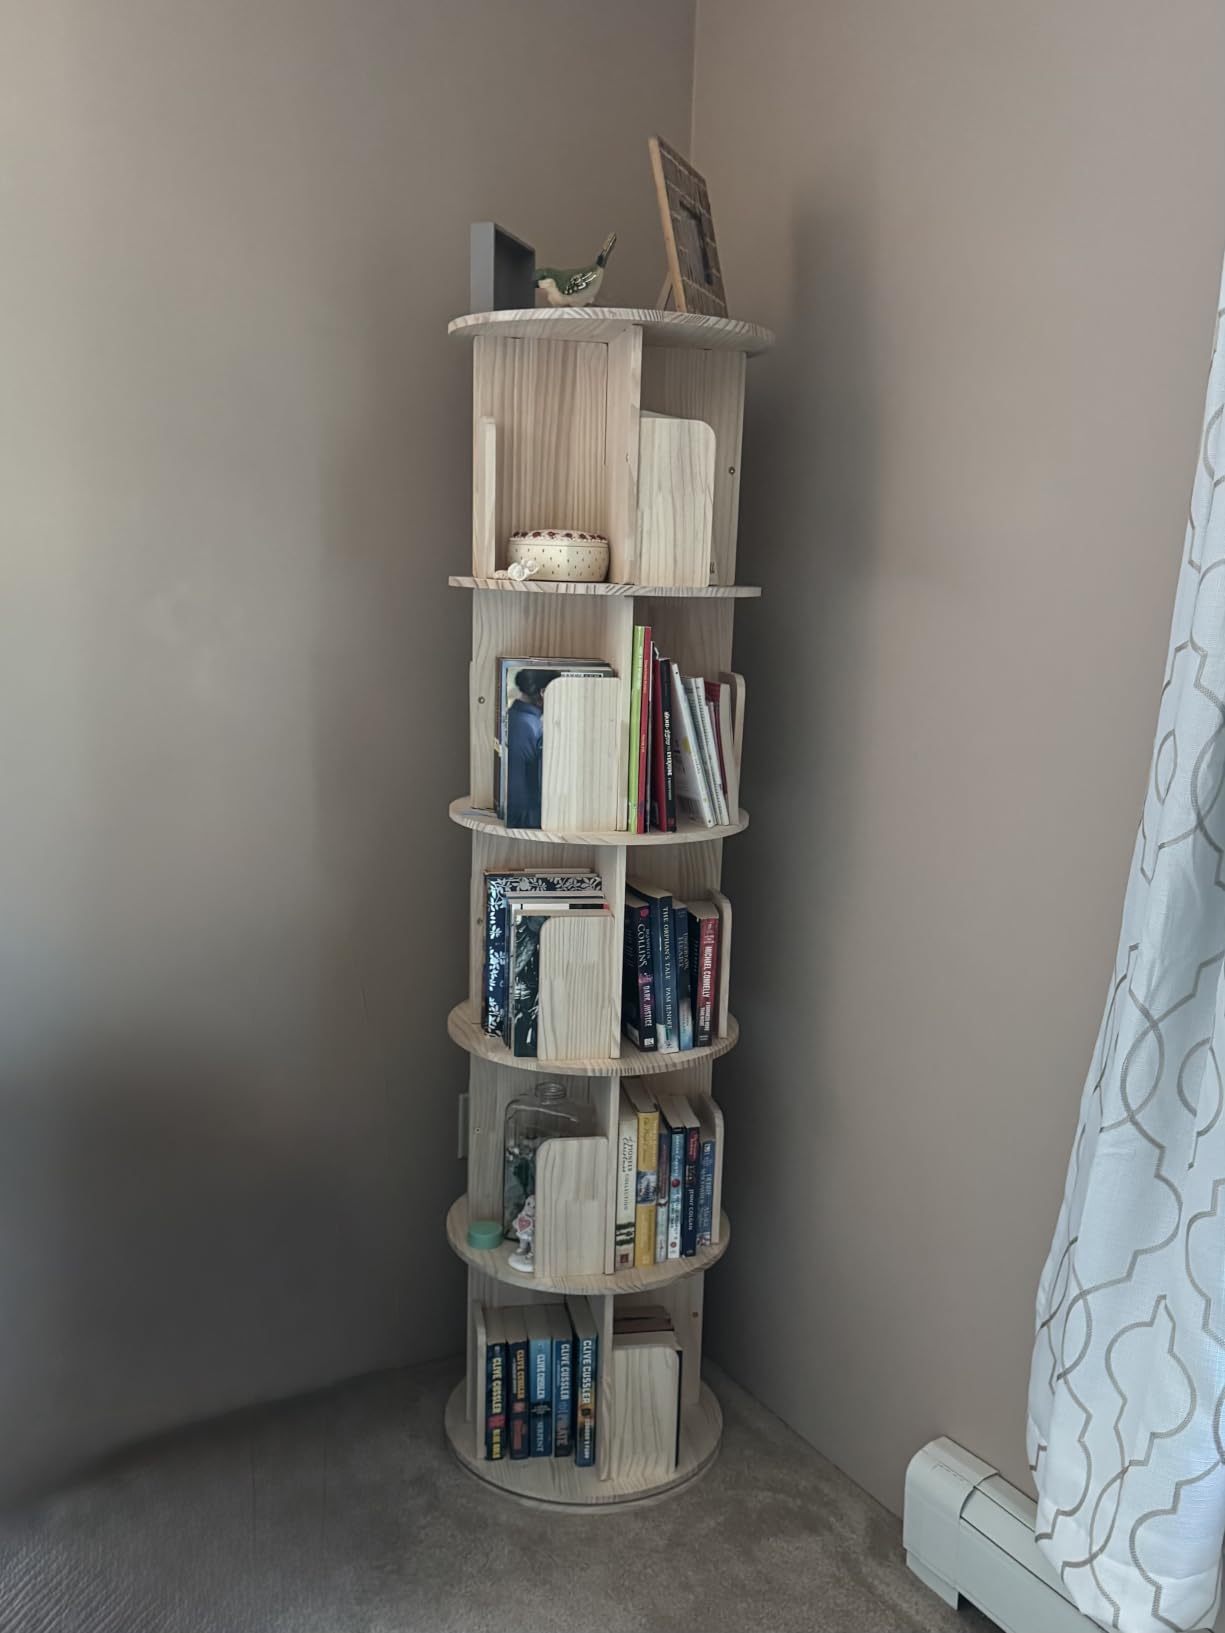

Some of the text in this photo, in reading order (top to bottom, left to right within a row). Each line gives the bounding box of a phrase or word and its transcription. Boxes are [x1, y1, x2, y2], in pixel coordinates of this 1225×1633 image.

[636, 924, 648, 967] COLLINS
[704, 945, 713, 969] MICHAEL
[702, 970, 712, 998] CONNELLY
[643, 985, 652, 1027] DARK JUSTICE
[516, 1350, 525, 1369] CLIVE
[536, 1354, 545, 1372] CLIVE
[561, 1344, 570, 1365] CLIVE
[492, 1357, 502, 1415] CLIVE CUSSLER
[560, 1366, 570, 1400] CUSSLER
[582, 1340, 592, 1404] CLIVE CUSSLER
[536, 1421, 544, 1452] SERPENT
